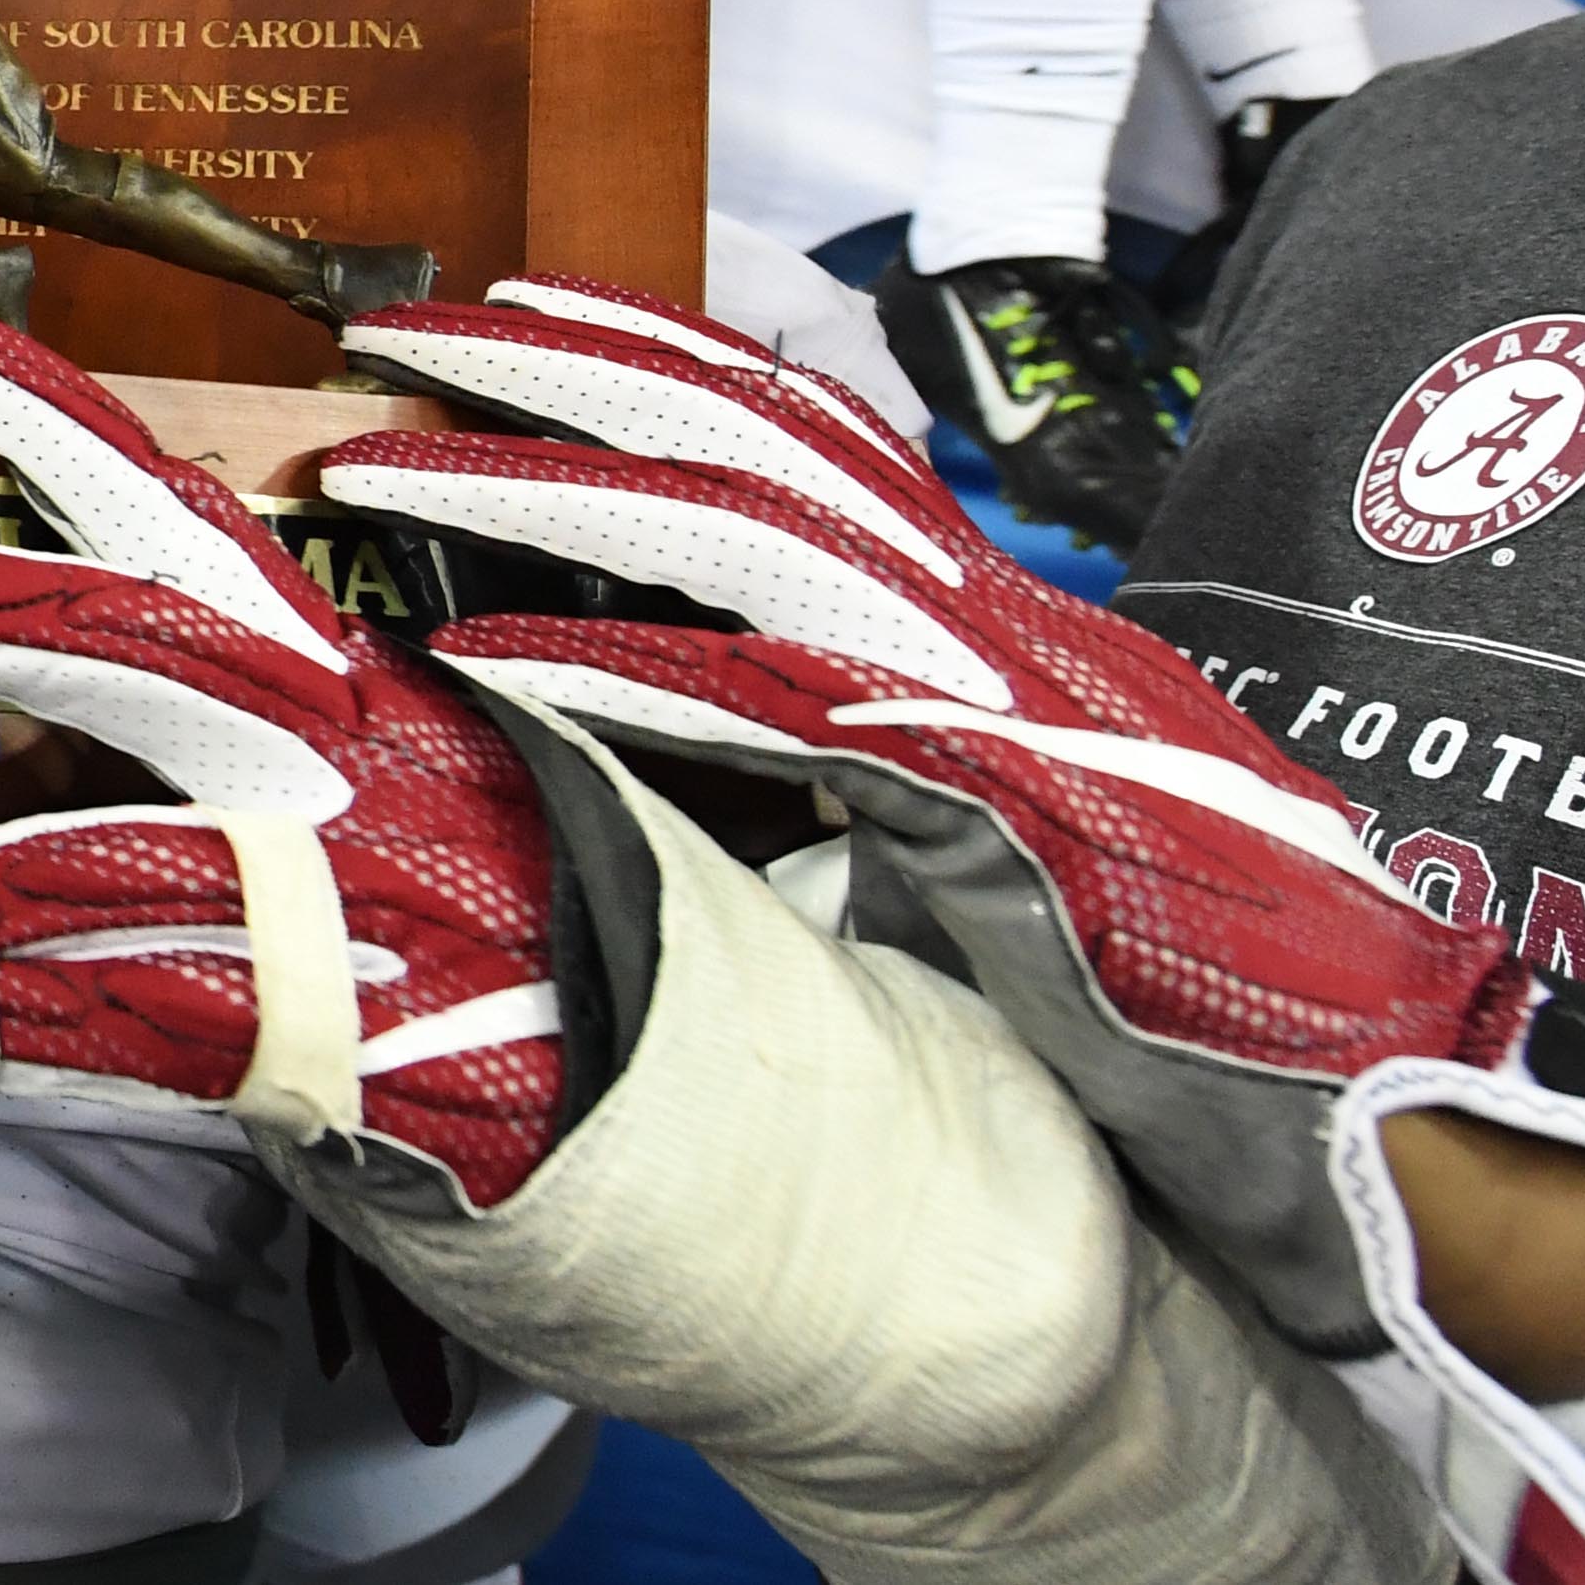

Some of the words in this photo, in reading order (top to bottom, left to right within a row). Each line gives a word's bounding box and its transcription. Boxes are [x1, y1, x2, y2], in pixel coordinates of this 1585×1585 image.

[43, 18, 186, 49] SOUTH
[200, 18, 424, 50] CAROLINA
[42, 81, 93, 111] OF
[108, 81, 350, 114] TENNESSEE
[1415, 387, 1565, 489] A
[1364, 447, 1461, 551] CRIMSON
[1469, 466, 1573, 542] TIDE
